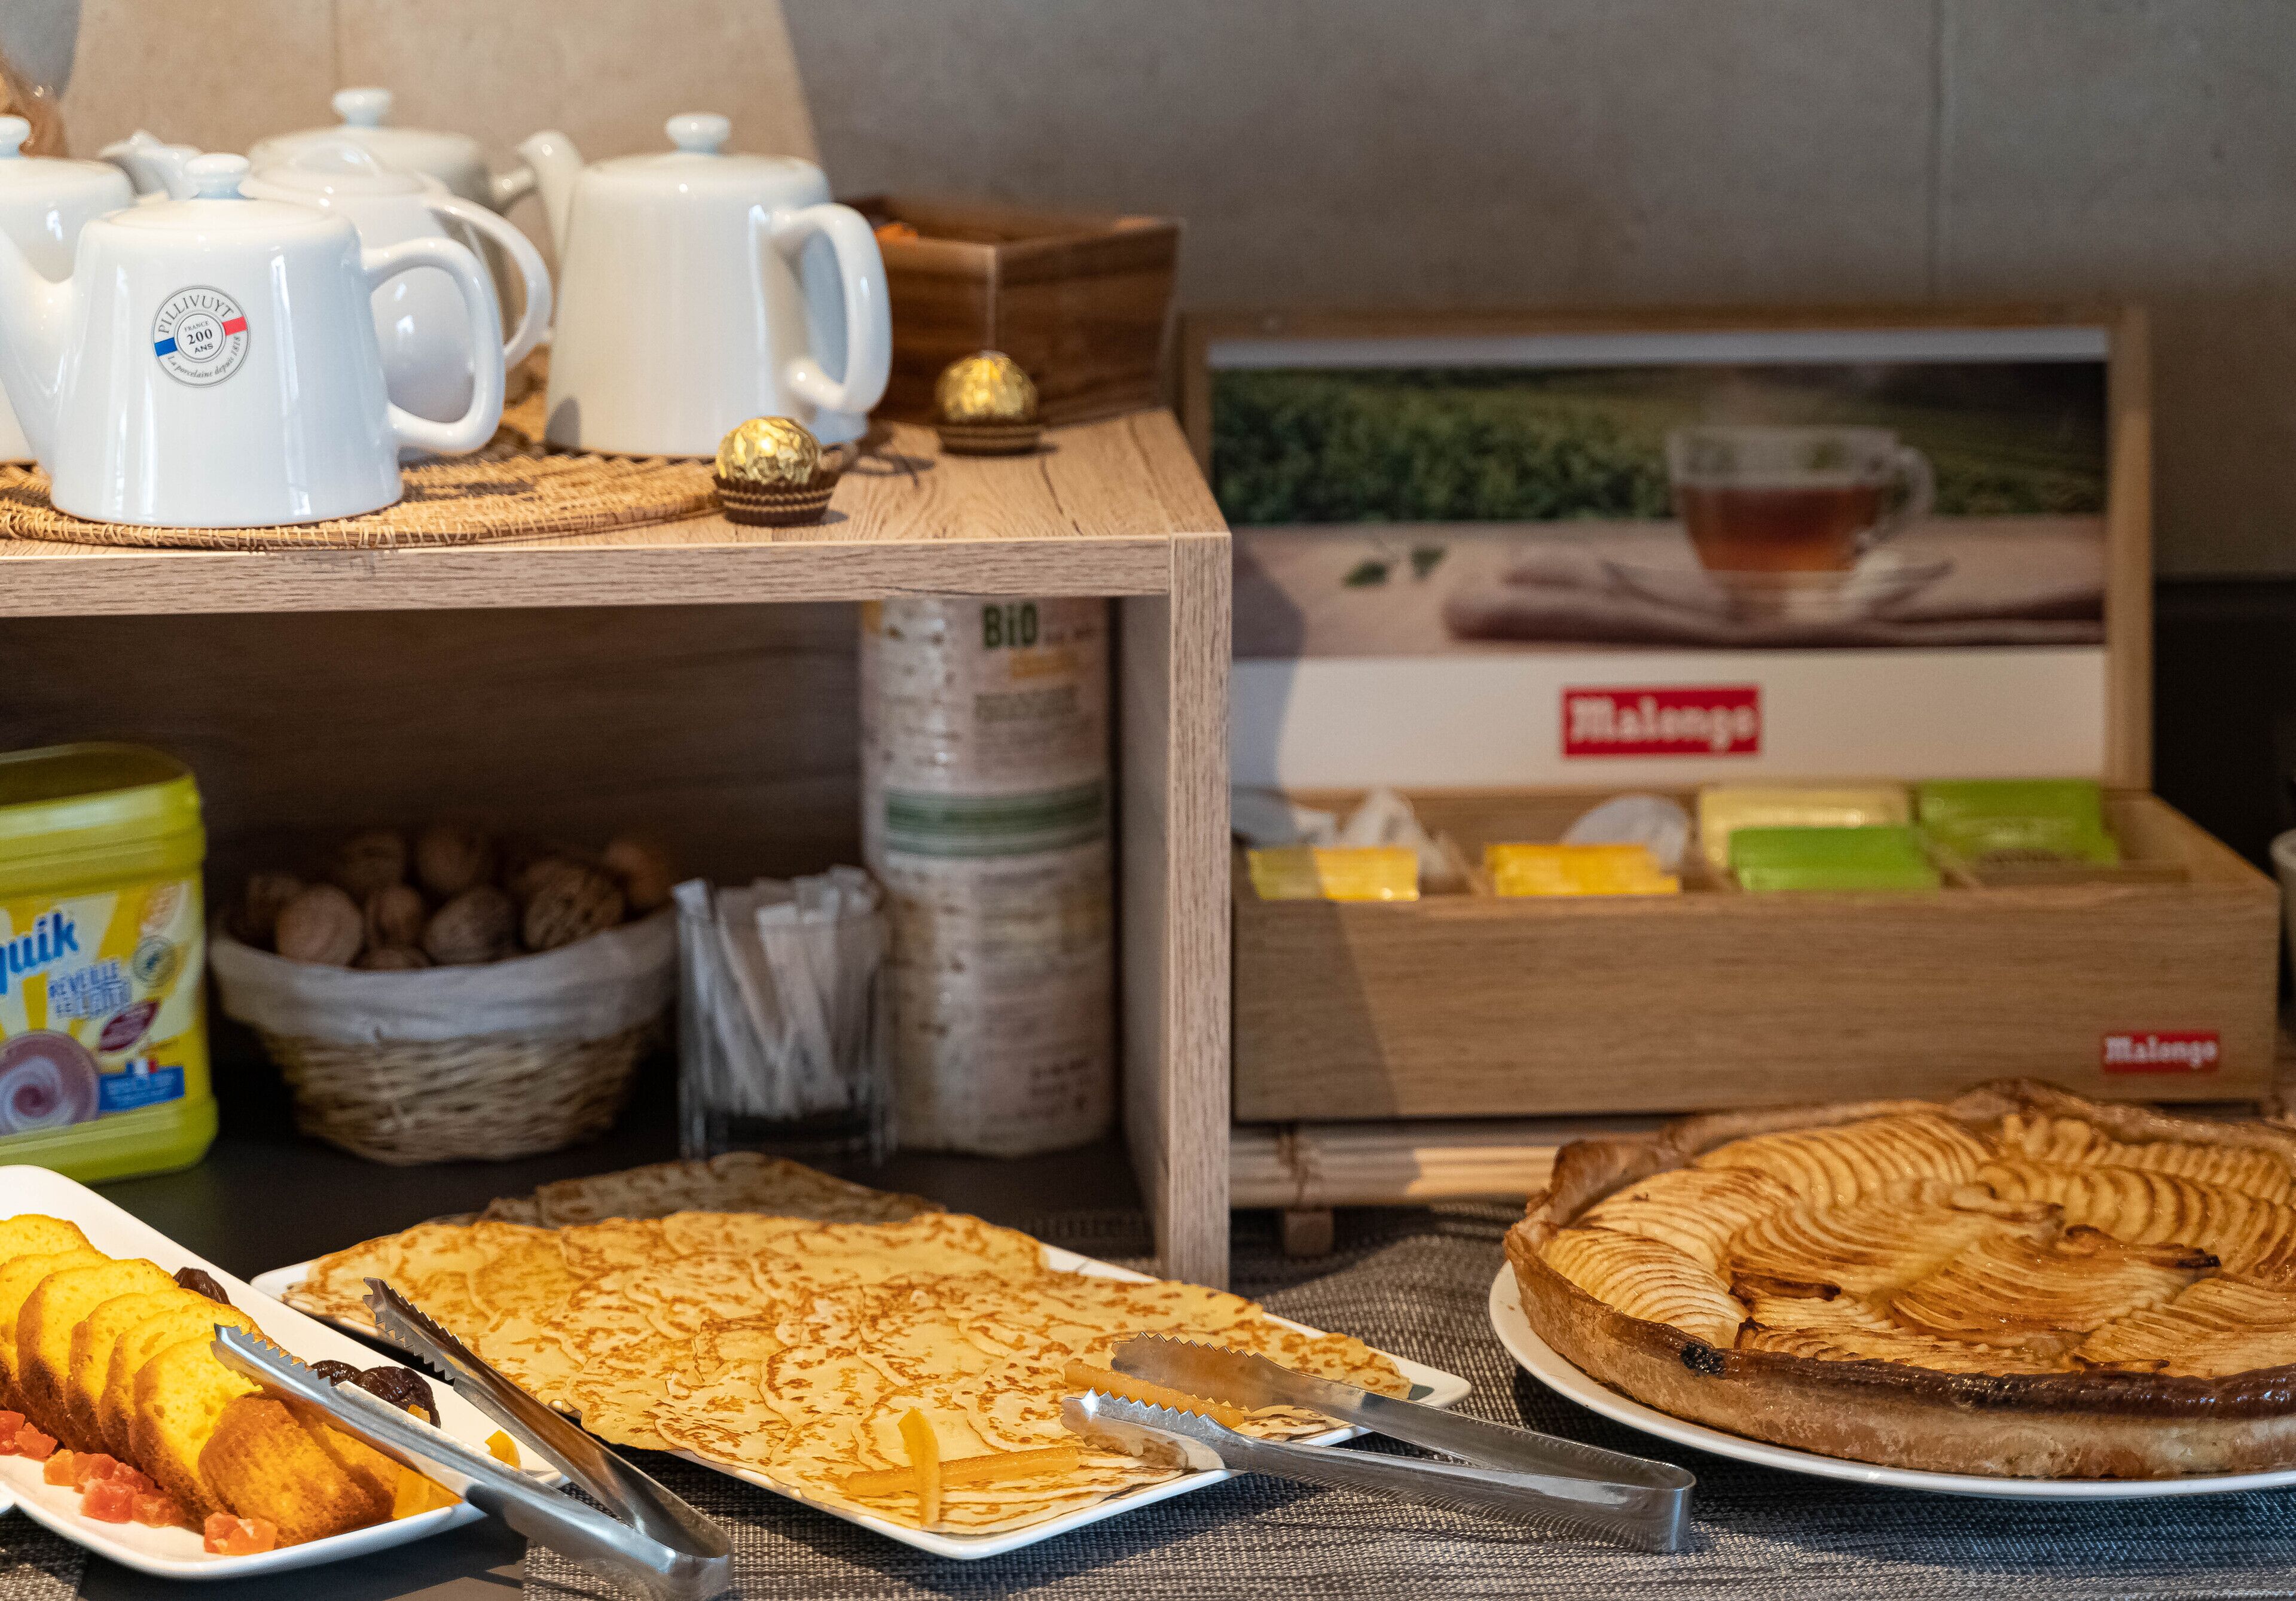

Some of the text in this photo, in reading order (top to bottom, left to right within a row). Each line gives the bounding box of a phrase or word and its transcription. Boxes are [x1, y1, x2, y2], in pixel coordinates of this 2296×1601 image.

[158, 295, 234, 334] PILLIVUYT
[184, 321, 209, 332] FRANCE
[187, 329, 213, 345] 200
[195, 343, 213, 354] ANS
[175, 364, 212, 378] porcelaine
[215, 356, 234, 374] depuis
[2105, 1036, 2217, 1069] Malongo
